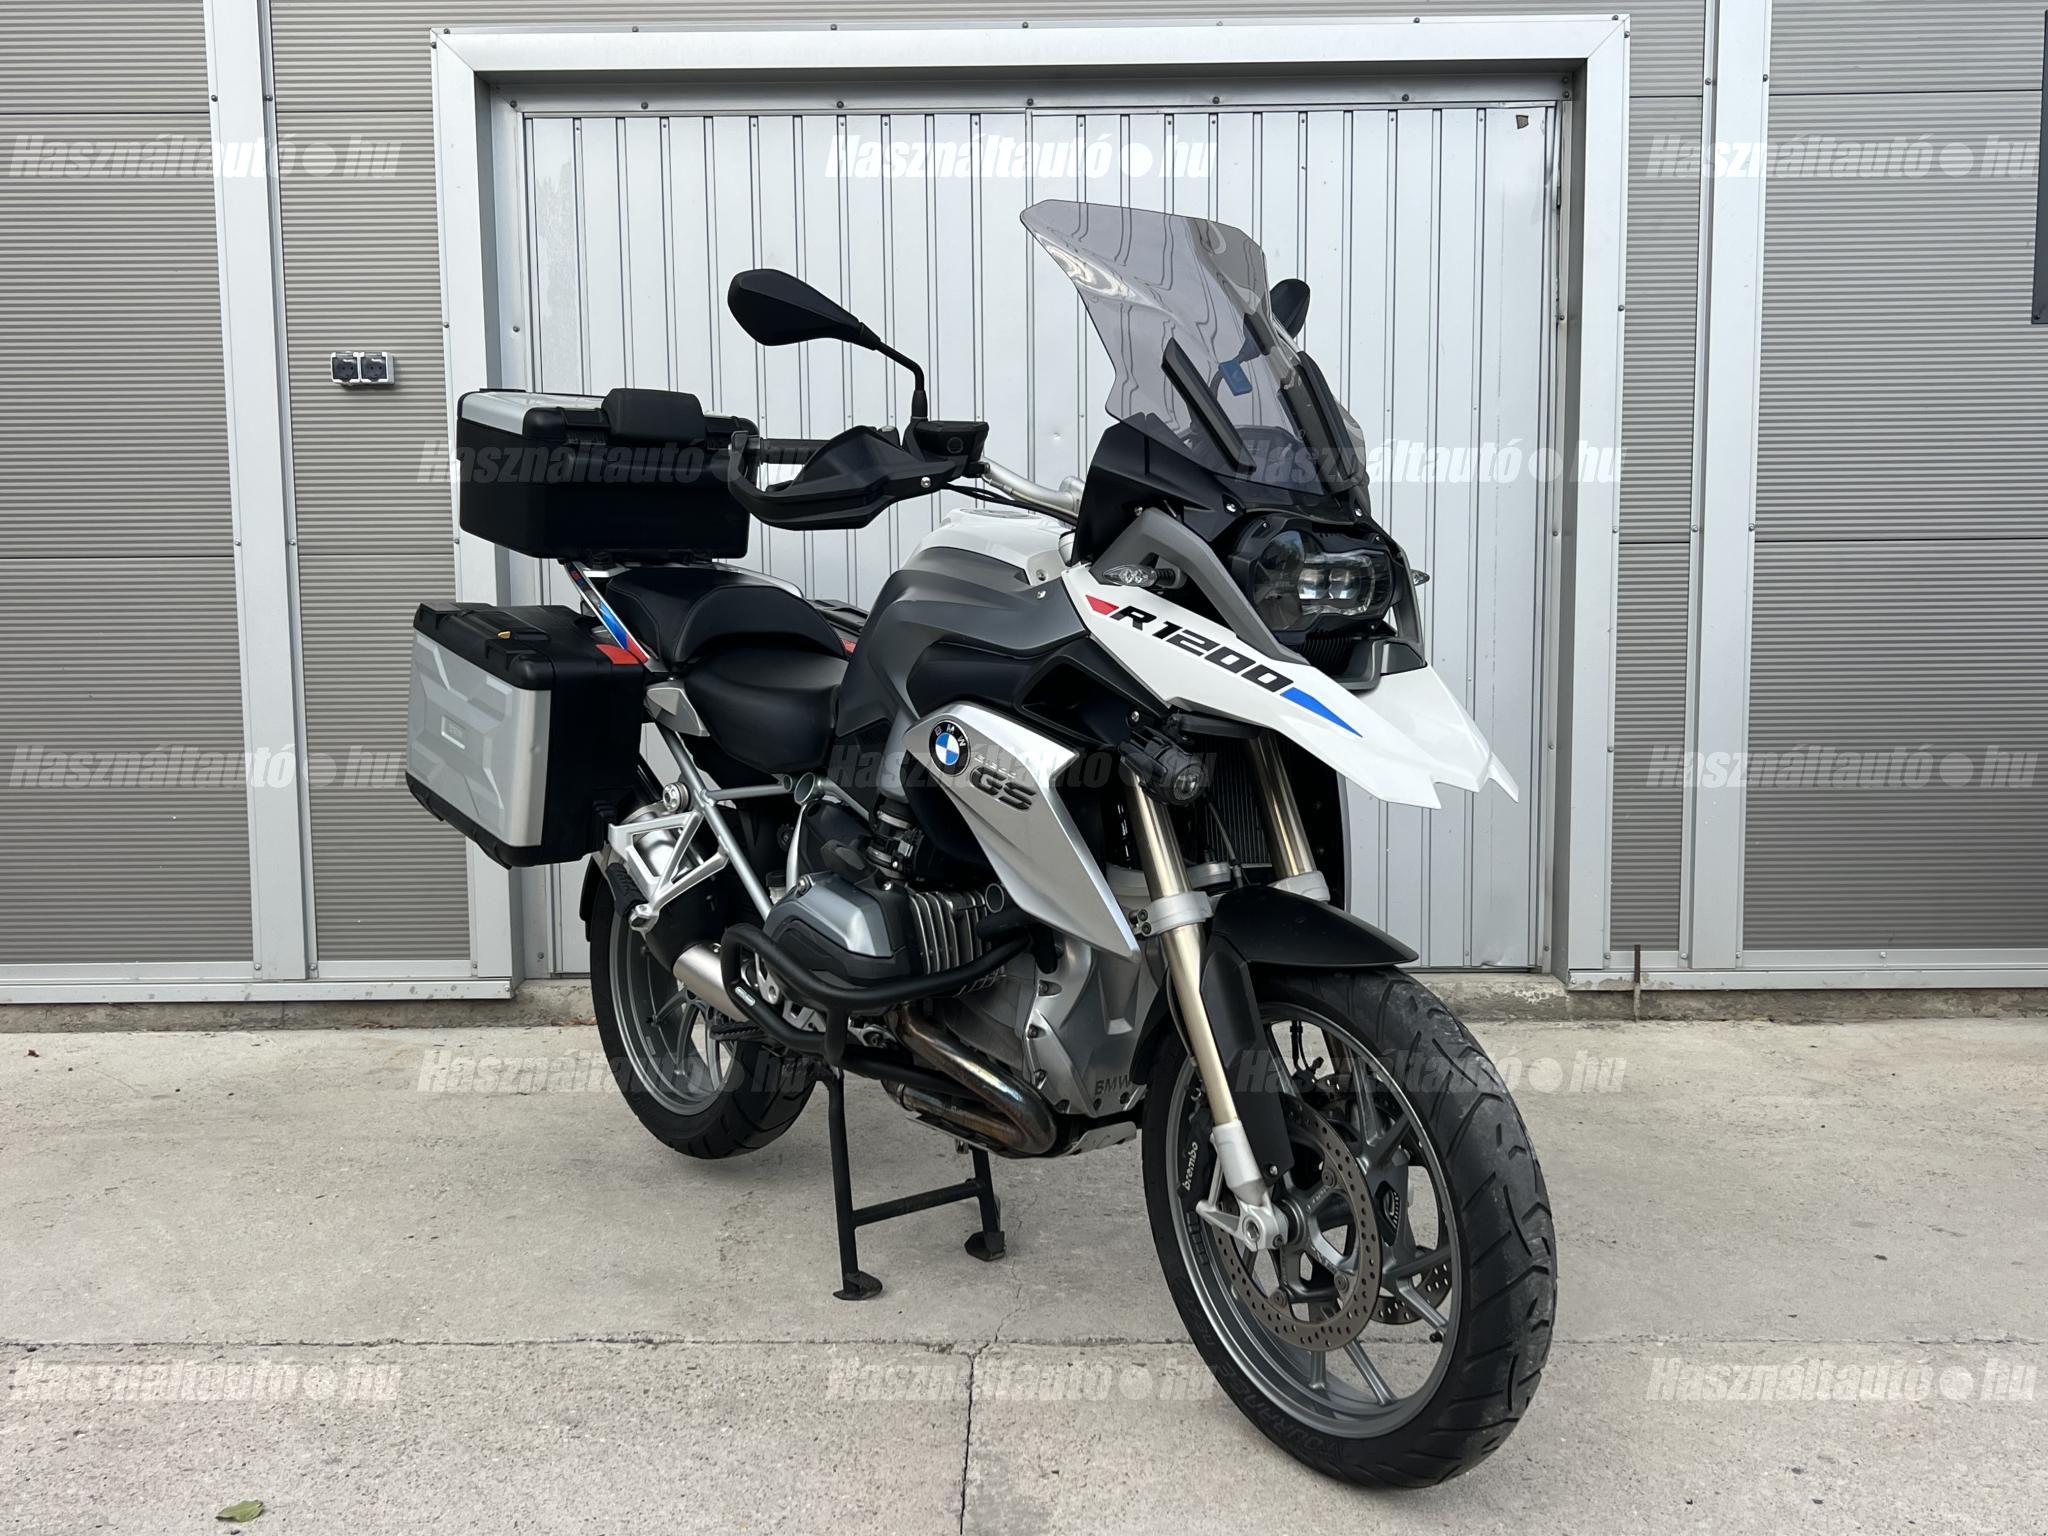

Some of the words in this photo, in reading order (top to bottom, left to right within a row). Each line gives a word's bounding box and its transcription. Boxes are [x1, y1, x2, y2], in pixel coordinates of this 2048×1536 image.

[1109, 605, 1157, 631] R
[1152, 621, 1294, 693] 1200
[934, 723, 967, 747] BMW
[970, 766, 1037, 810] GS
[1095, 1074, 1131, 1095] BMW
[1181, 1141, 1199, 1192] brembo
